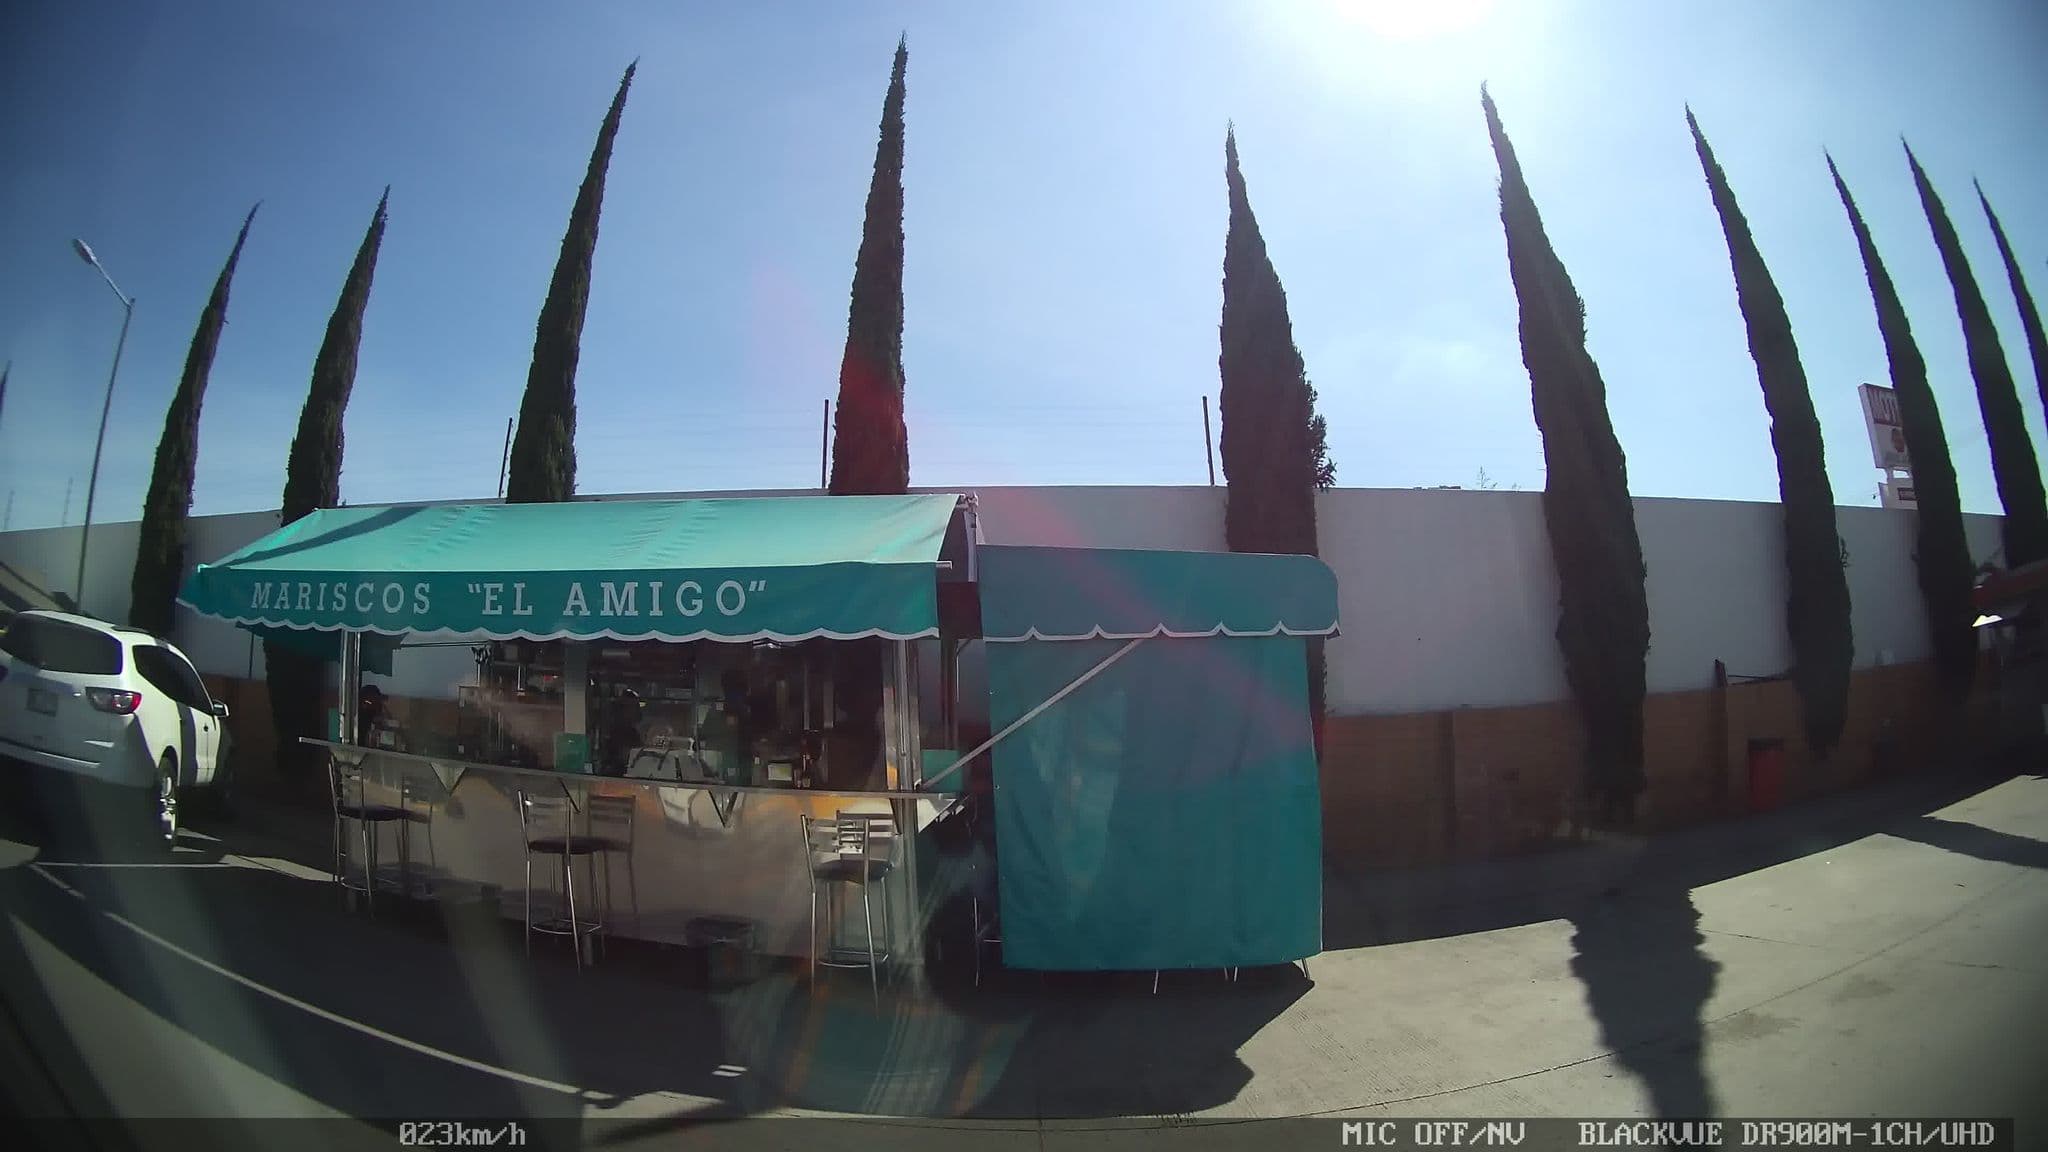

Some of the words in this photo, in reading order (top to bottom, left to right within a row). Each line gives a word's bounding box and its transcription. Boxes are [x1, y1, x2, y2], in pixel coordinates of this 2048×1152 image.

[251, 582, 431, 615] MARISCOS
[468, 582, 534, 617] "EL
[563, 580, 768, 617] AMIGO"
